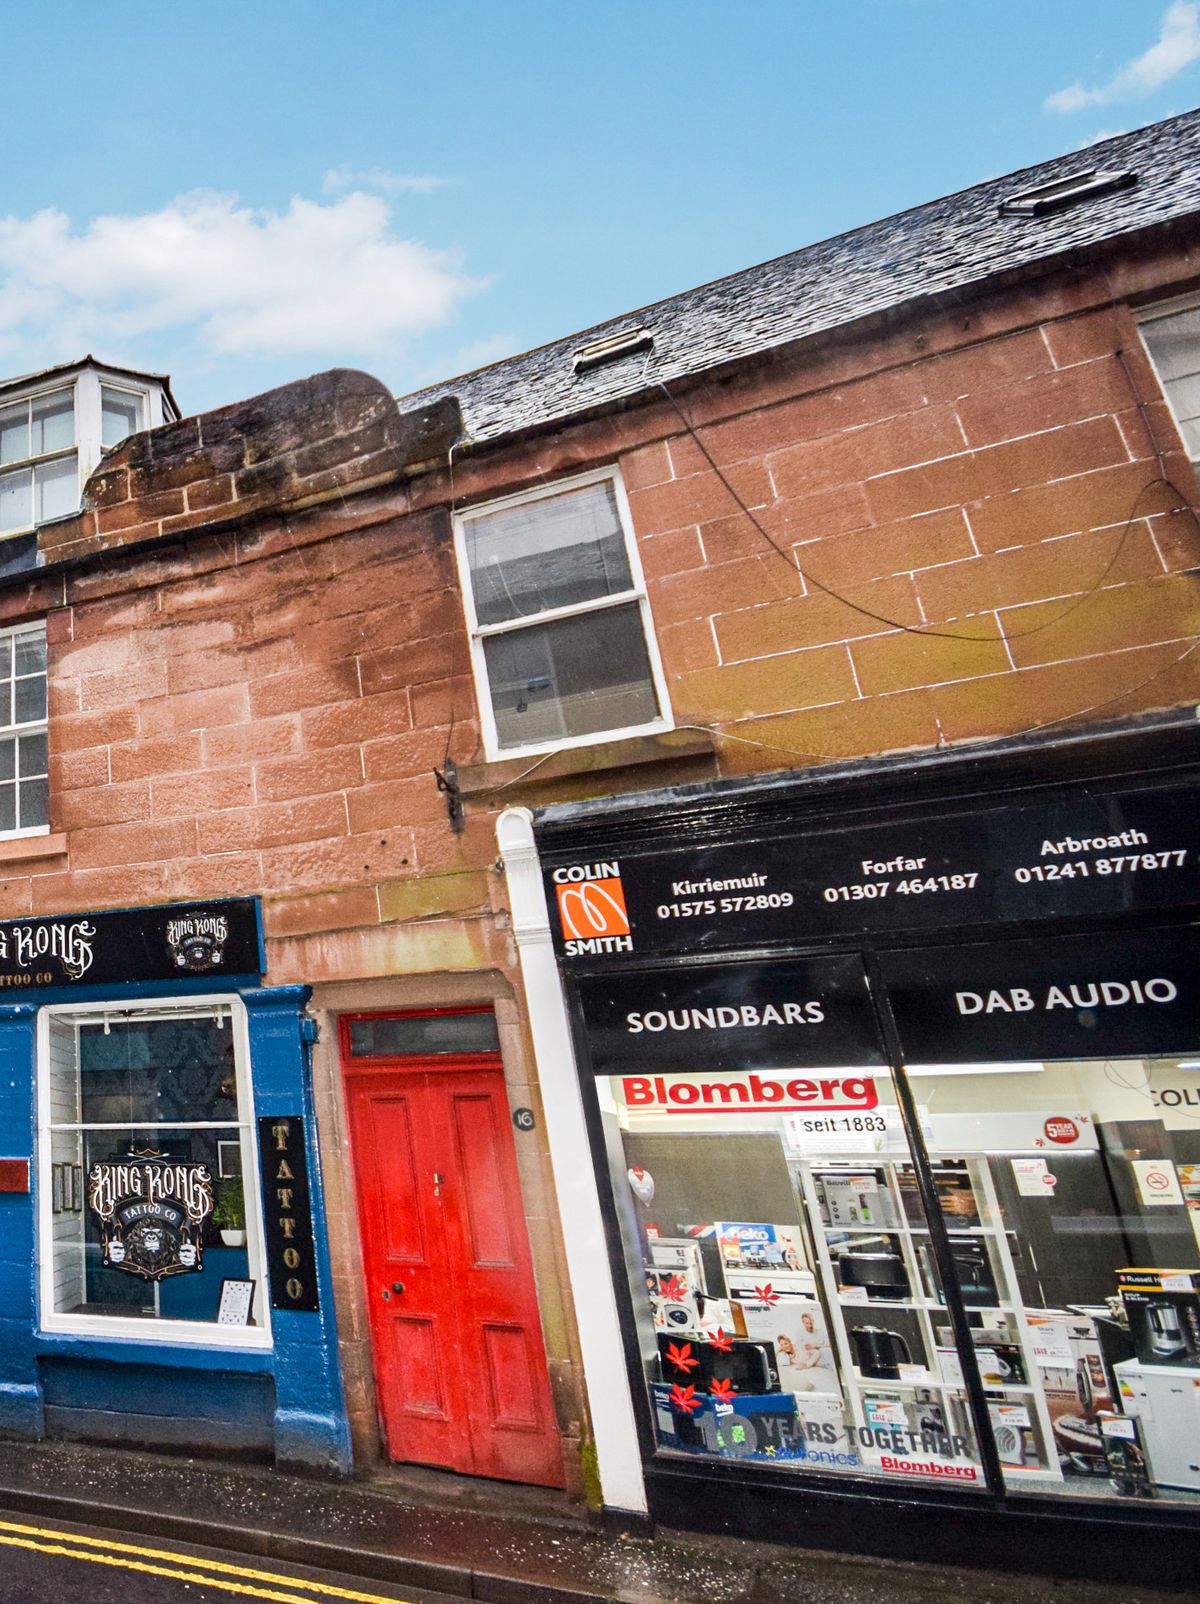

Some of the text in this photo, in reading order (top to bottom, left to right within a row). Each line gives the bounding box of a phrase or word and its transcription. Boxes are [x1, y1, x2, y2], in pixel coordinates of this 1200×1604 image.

[1041, 829, 1148, 855] Arbroath
[553, 861, 620, 884] COLIN
[862, 856, 926, 875] Forfar
[1014, 849, 1187, 883] 01241 877877
[672, 873, 768, 896] Kirriemuir
[824, 873, 979, 902] 01307 464187
[657, 892, 794, 919] 01575 572809
[167, 916, 228, 947] KING KONG
[12, 920, 97, 979] KONG
[565, 935, 633, 957] SMITH
[35, 971, 53, 984] CO
[955, 978, 1177, 1015] DAB AUDIO
[627, 1001, 825, 1033] SOUNDBARS
[622, 1075, 879, 1110] Blomberg
[517, 1112, 533, 1126] 16
[803, 1118, 837, 1132] seit
[841, 1117, 886, 1132] 1883
[1046, 1123, 1058, 1137] 5
[90, 1165, 211, 1224] KING KONG
[125, 1203, 177, 1221] TATTOO CO
[272, 1125, 303, 1299] TATTOO
[714, 1403, 733, 1412] beko
[693, 1411, 972, 1458] 10 YEARS TOGETHER
[880, 1456, 976, 1480] Blomberg
